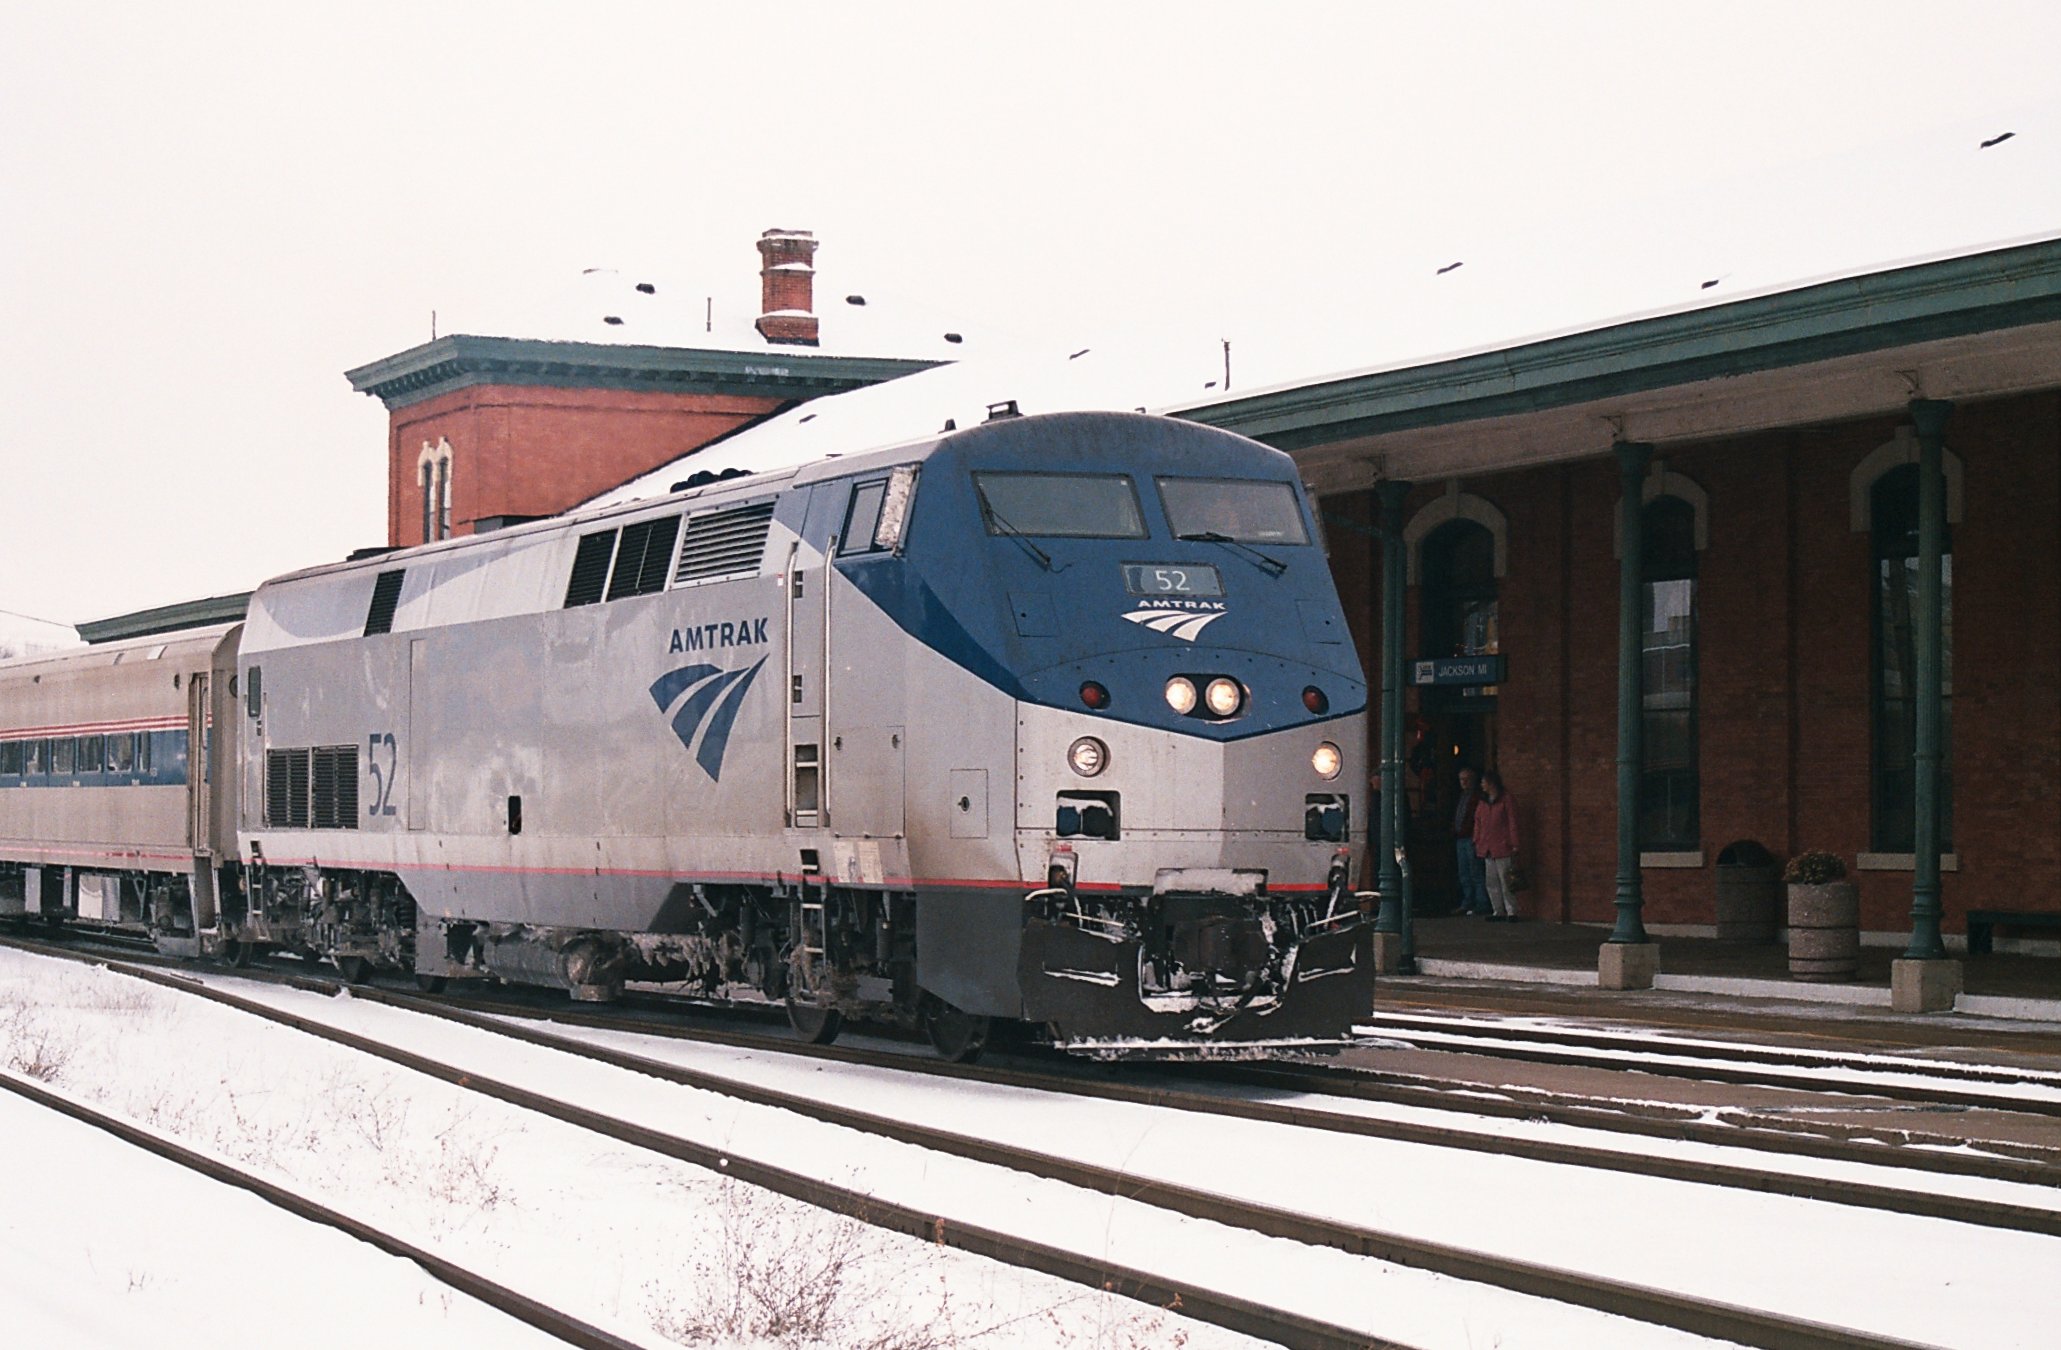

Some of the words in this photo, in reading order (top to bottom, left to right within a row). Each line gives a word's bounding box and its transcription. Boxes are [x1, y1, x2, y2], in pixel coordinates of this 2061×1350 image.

[1155, 570, 1190, 591] 52
[1138, 600, 1226, 610] AMTRAK
[669, 617, 768, 654] AMTRAK
[1438, 664, 1475, 677] JACKSON
[1477, 664, 1487, 675] MI
[369, 733, 396, 816] 52
